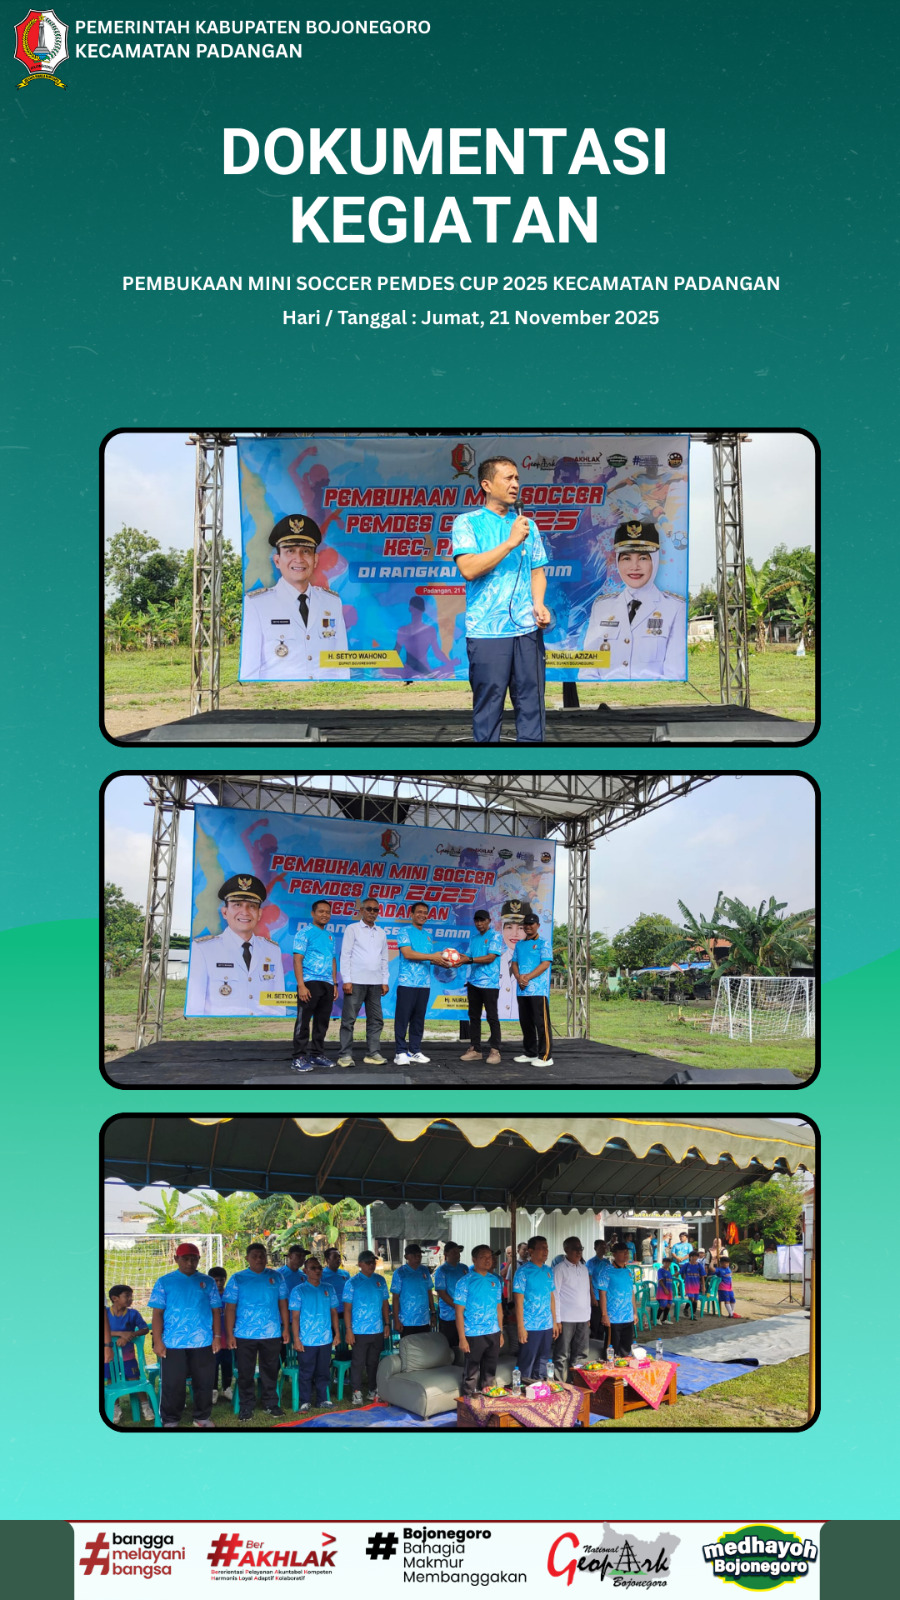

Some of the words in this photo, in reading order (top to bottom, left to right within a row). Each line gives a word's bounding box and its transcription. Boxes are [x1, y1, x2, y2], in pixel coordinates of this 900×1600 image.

[323, 487, 458, 507] PEMBUKAAN
[521, 486, 605, 506] SOCCER
[345, 515, 434, 533] PEMDES
[383, 538, 430, 556] KEC.
[358, 566, 377, 578] DI
[379, 566, 457, 578] RANGKAI
[270, 854, 385, 878] PEMBUKAAN
[388, 864, 429, 881] MINI
[432, 867, 496, 886] SOCCER
[288, 878, 364, 898] PEMDES
[368, 883, 402, 900] CUP
[405, 884, 479, 904] 2025
[329, 901, 358, 916] EC.
[435, 928, 471, 939] BMM
